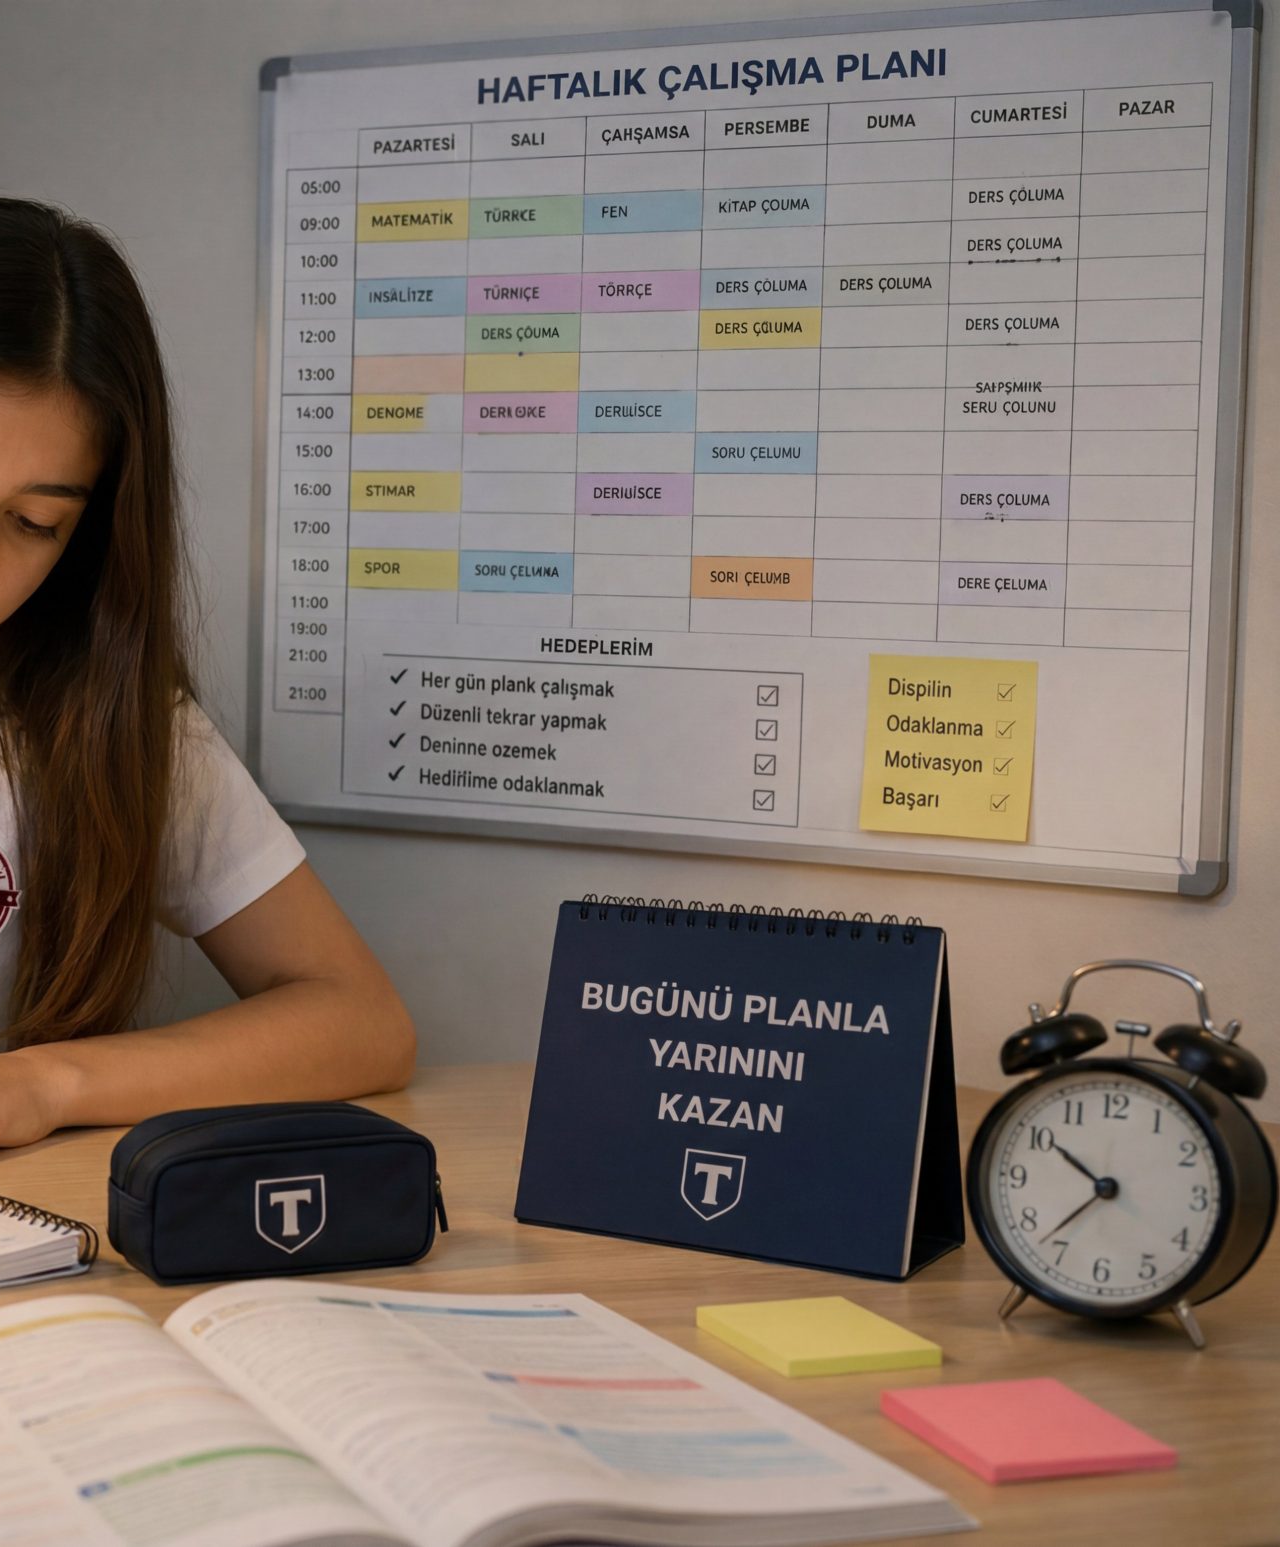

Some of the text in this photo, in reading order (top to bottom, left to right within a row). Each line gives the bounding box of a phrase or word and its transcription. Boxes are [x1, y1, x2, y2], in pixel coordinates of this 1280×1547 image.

[477, 48, 947, 105] HAFTALIK ÇALIŞMA PLANI
[970, 101, 1068, 125] CUMARTESİ
[1118, 99, 1176, 117] PAZAR
[724, 118, 810, 136] PERSEMBE
[866, 113, 916, 130] DUMA
[373, 133, 456, 155] PAZARTESİ
[511, 132, 545, 148] SALI
[301, 180, 341, 195] 05:00
[718, 198, 757, 213] KİTAP
[969, 190, 1004, 204] DERS
[371, 209, 453, 227] MATEMATİK
[601, 206, 628, 218] FEN
[300, 217, 340, 231] 09:00
[967, 237, 1063, 254] DERS ÇOLUMA
[300, 254, 338, 268] 10:00
[716, 280, 749, 294] DERS
[839, 277, 932, 293] DERS ÇOLUMA
[300, 292, 336, 306] 11:00
[481, 327, 512, 340] DERS
[715, 322, 748, 334] DERS
[965, 317, 1060, 333] DERS ÇOLUMA
[299, 330, 336, 343] 12:00
[297, 368, 335, 381] 13:00
[296, 406, 334, 419] 14:00
[963, 401, 1056, 416] SERU ÇOLUNU
[295, 444, 333, 458] 15:00
[712, 446, 801, 462] SORU ÇELUMU
[293, 483, 332, 496] 16:00
[960, 493, 1050, 509] DERS ÇOLUMA
[293, 521, 331, 535] 17:00
[291, 559, 330, 572] 18:00
[364, 562, 401, 575] SPOR
[474, 564, 506, 577] SORU
[710, 570, 738, 583] SORI
[957, 577, 1048, 593] DERE ÇELUMA
[291, 596, 329, 610] 11:00
[289, 622, 328, 636] 19:00
[539, 636, 654, 657] HEDEPLERİM
[289, 648, 328, 663] 21:00
[288, 687, 327, 701] 21:00
[421, 671, 615, 701] Her gün plank çalışmak
[888, 677, 952, 702] Dispilin
[420, 703, 607, 732] Düzenli tekrar yapmak
[886, 714, 984, 737] Odaklanma
[420, 735, 557, 761] Deninne ozemek
[884, 749, 983, 776] Motivasyon
[503, 775, 605, 798] odaklanmak
[882, 786, 939, 811] Başarı
[581, 980, 890, 1035] BUGÜNÜ PLANLA
[649, 1038, 805, 1082] YARININI
[657, 1091, 784, 1133] KAZAN
[1063, 1099, 1084, 1126] 11
[1102, 1093, 1130, 1120] 12
[1152, 1108, 1162, 1134] 1
[1029, 1125, 1054, 1152] 10
[1178, 1140, 1198, 1168] 2
[693, 1161, 733, 1206] T
[1009, 1163, 1027, 1190] 9
[1189, 1185, 1208, 1213] 3
[270, 1188, 312, 1237] T
[1020, 1207, 1038, 1233] 8
[1171, 1227, 1190, 1253] 4
[1052, 1239, 1069, 1267] 7
[1092, 1257, 1111, 1284] 6
[1137, 1253, 1157, 1281] 5
